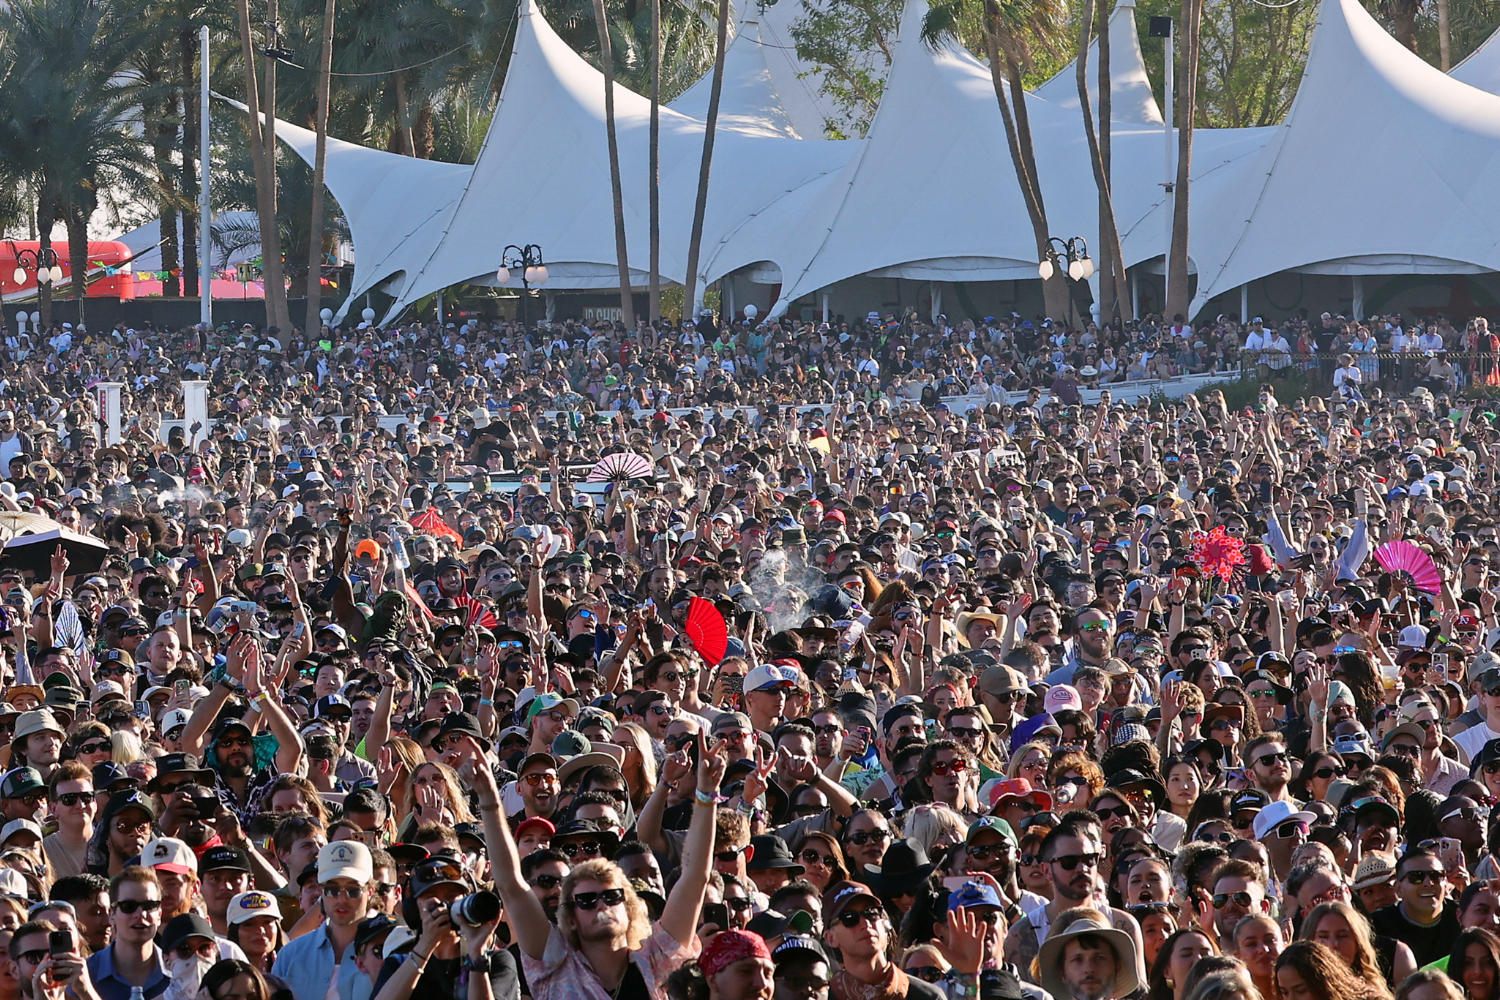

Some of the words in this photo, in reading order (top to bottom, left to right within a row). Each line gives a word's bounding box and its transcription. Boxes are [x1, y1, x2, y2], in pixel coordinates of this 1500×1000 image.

[596, 308, 625, 323] CHEC
[176, 712, 185, 723] LA
[126, 790, 143, 804] A
